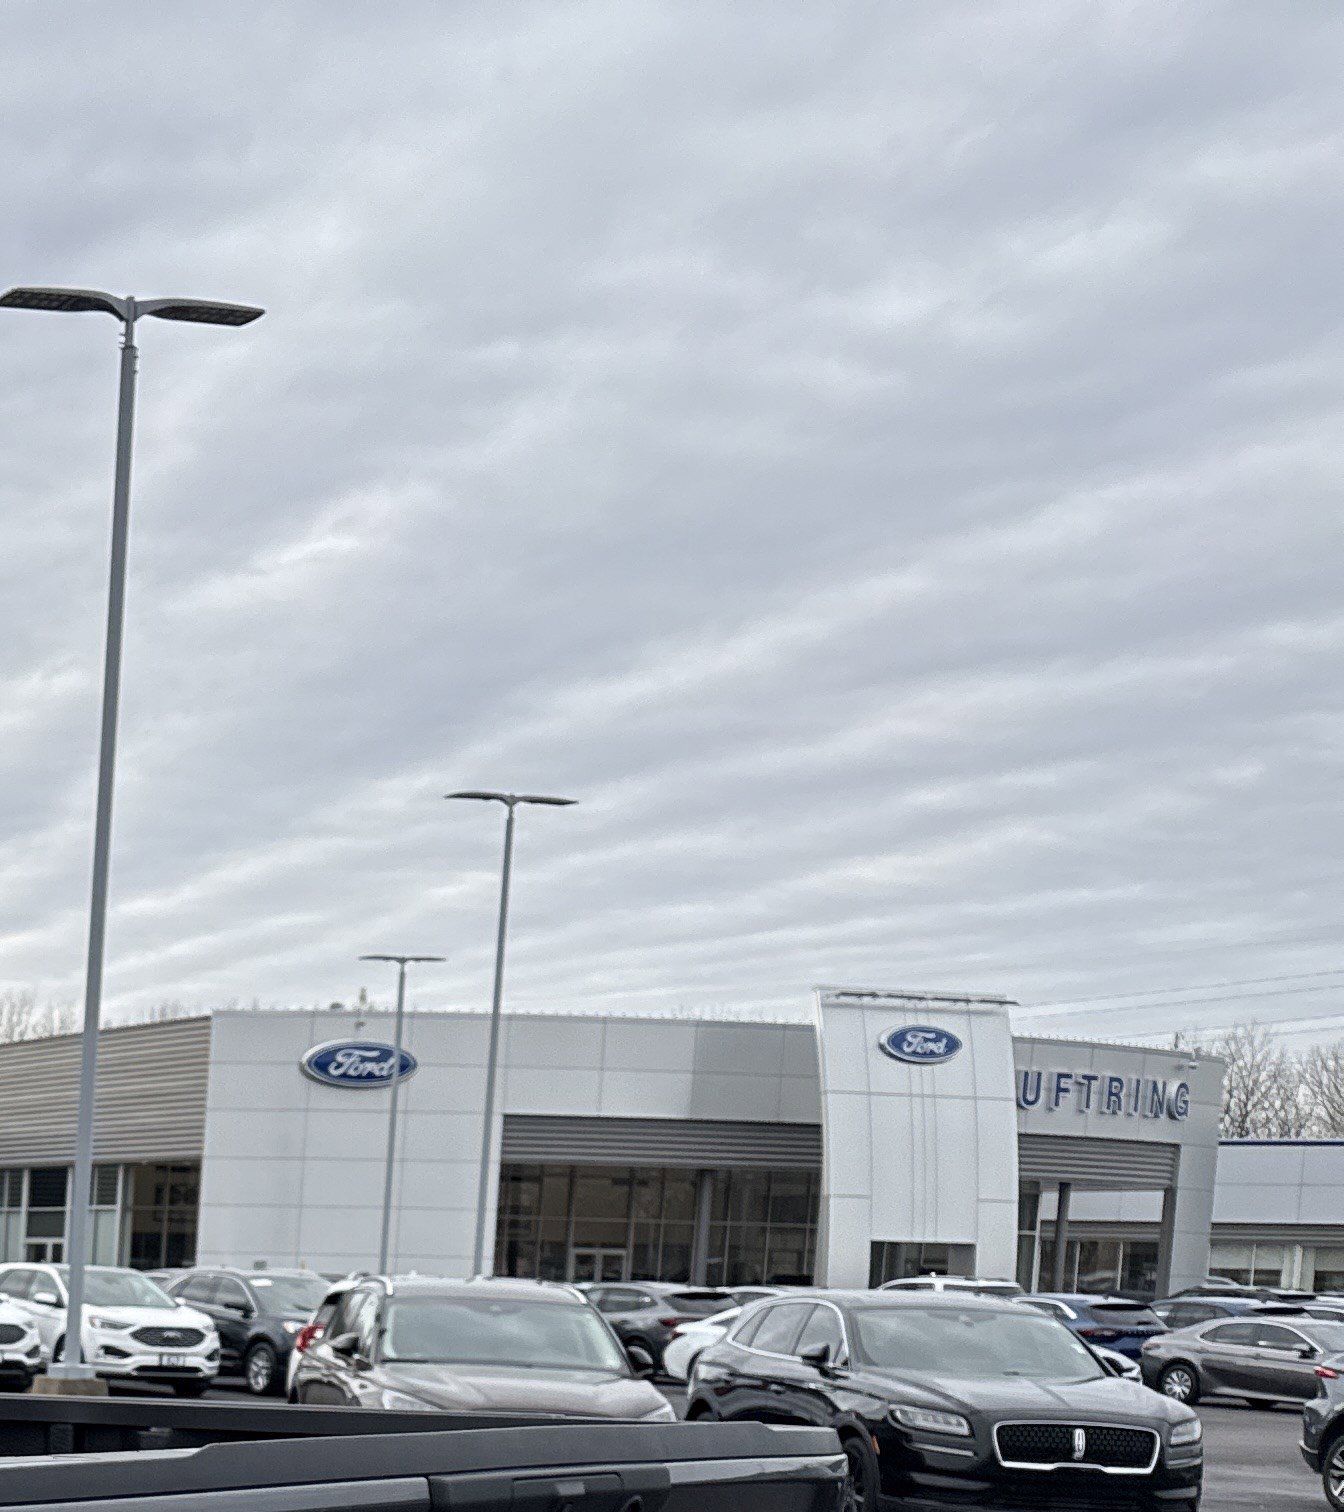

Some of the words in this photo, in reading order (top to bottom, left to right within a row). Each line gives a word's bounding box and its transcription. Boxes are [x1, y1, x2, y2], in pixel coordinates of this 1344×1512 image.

[902, 1030, 948, 1055] Ford
[328, 1048, 398, 1078] Ford
[1020, 1070, 1190, 1118] UFTRING
